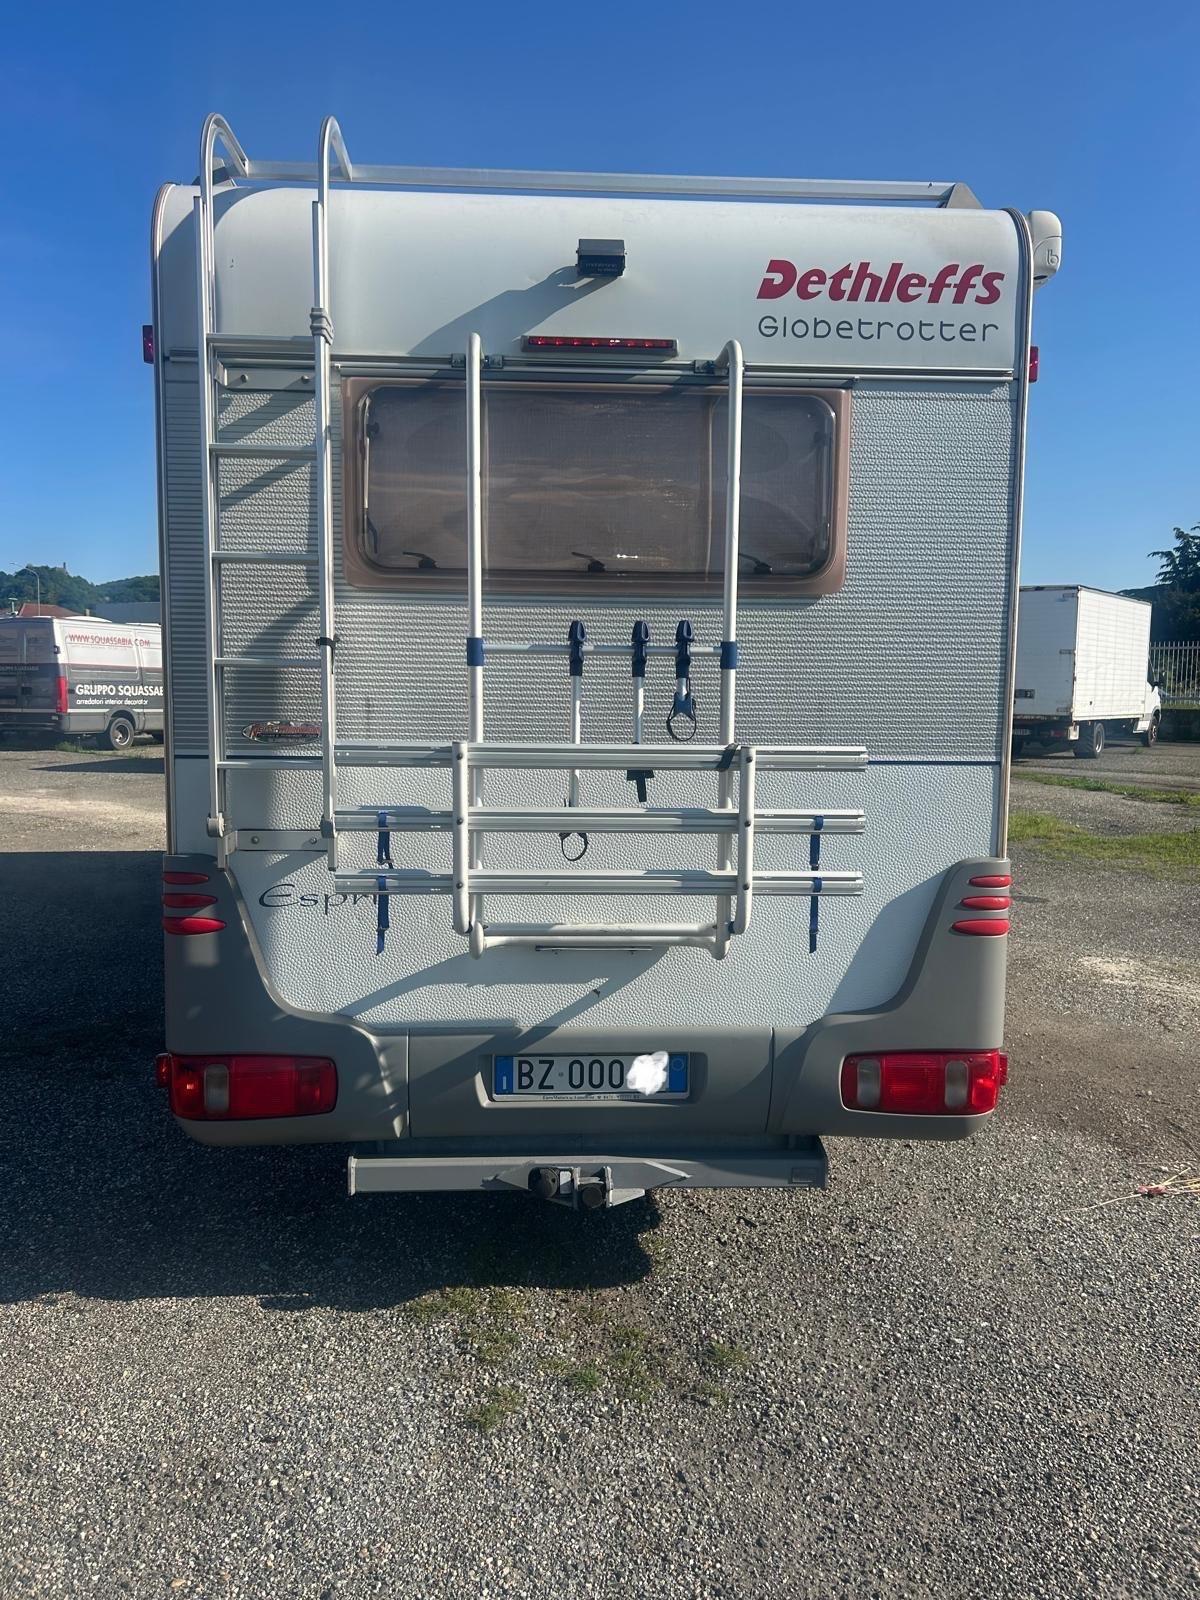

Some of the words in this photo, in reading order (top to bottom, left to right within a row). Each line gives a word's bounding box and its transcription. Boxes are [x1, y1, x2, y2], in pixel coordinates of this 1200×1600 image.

[756, 259, 1005, 305] Dethleffs
[758, 315, 999, 341] Globetrotter
[75, 684, 116, 696] GRUPPO
[105, 697, 123, 705] interior
[517, 1059, 555, 1090] BZ
